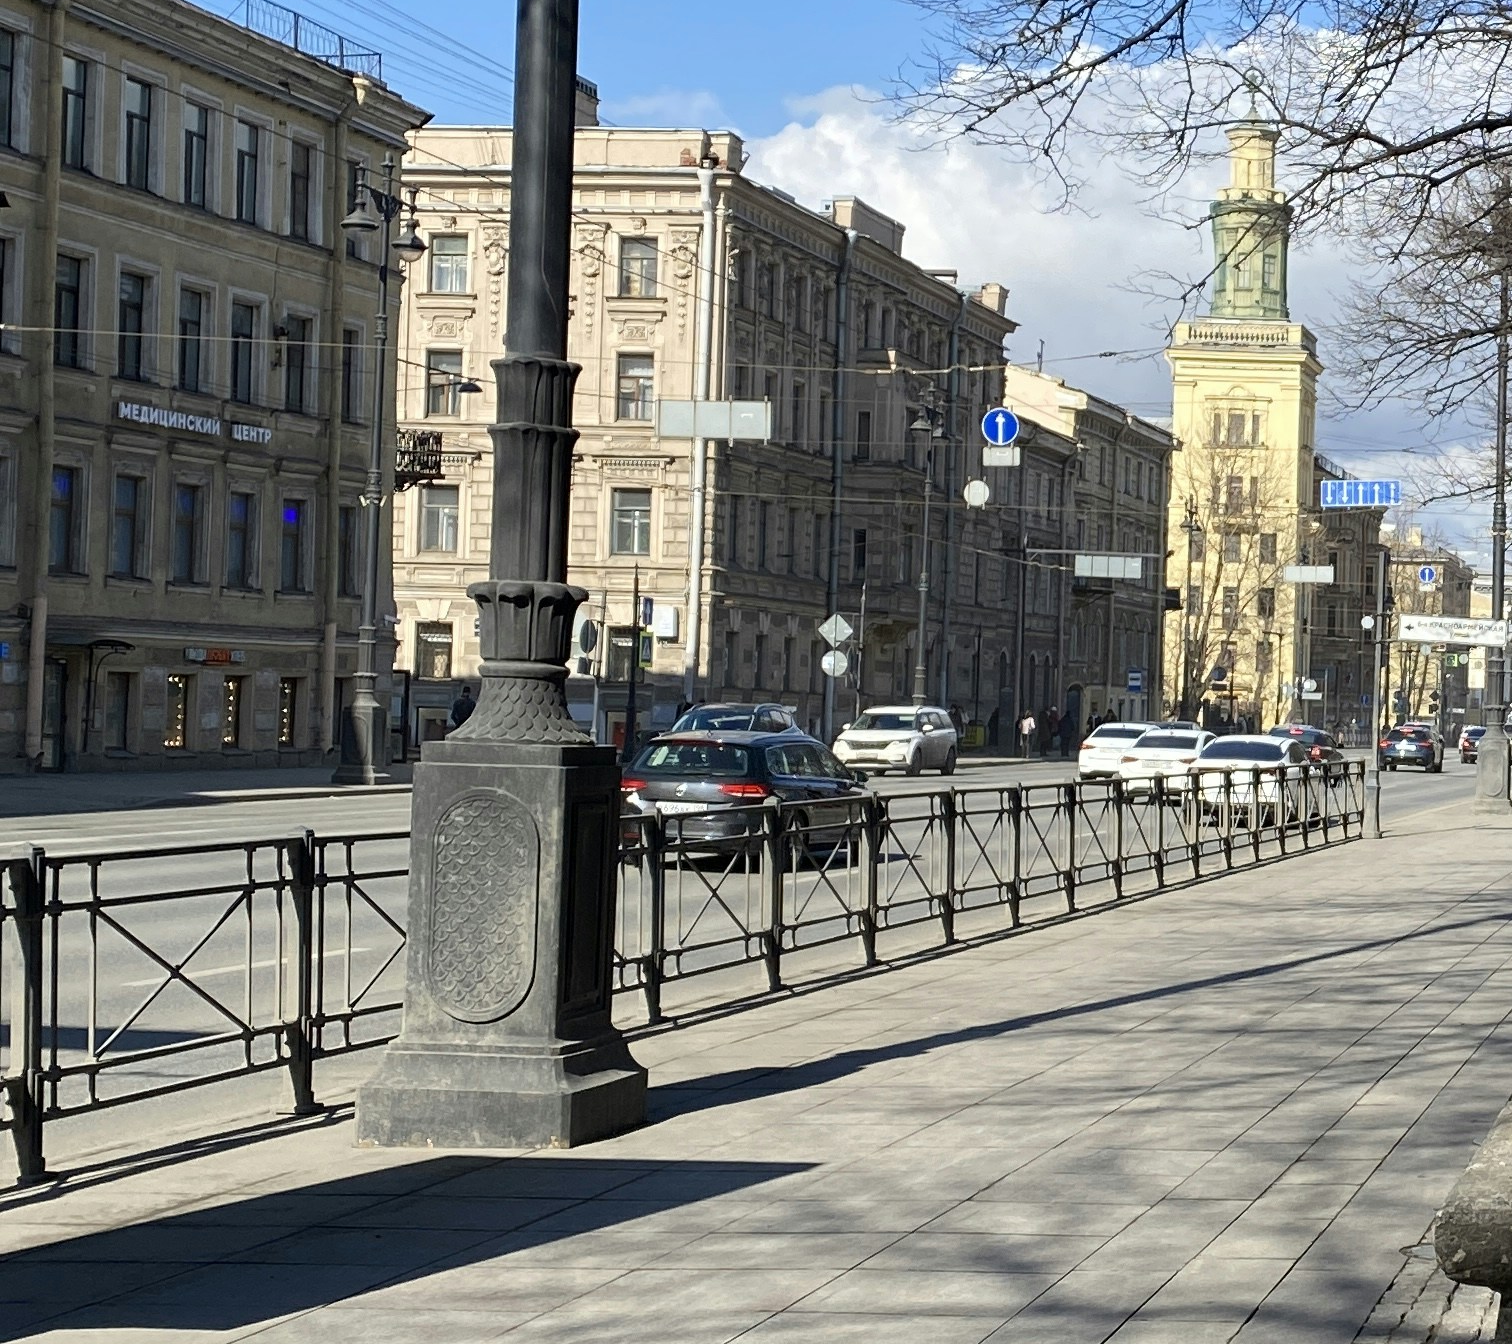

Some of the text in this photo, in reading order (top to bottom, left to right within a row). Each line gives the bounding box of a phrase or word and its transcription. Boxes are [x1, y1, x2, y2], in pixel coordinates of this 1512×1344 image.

[118, 401, 272, 444] МЕДИЦИНСКИЙ ЦЕНТР
[1429, 621, 1504, 632] КРАСНОАРМЕЙСКАЯ
